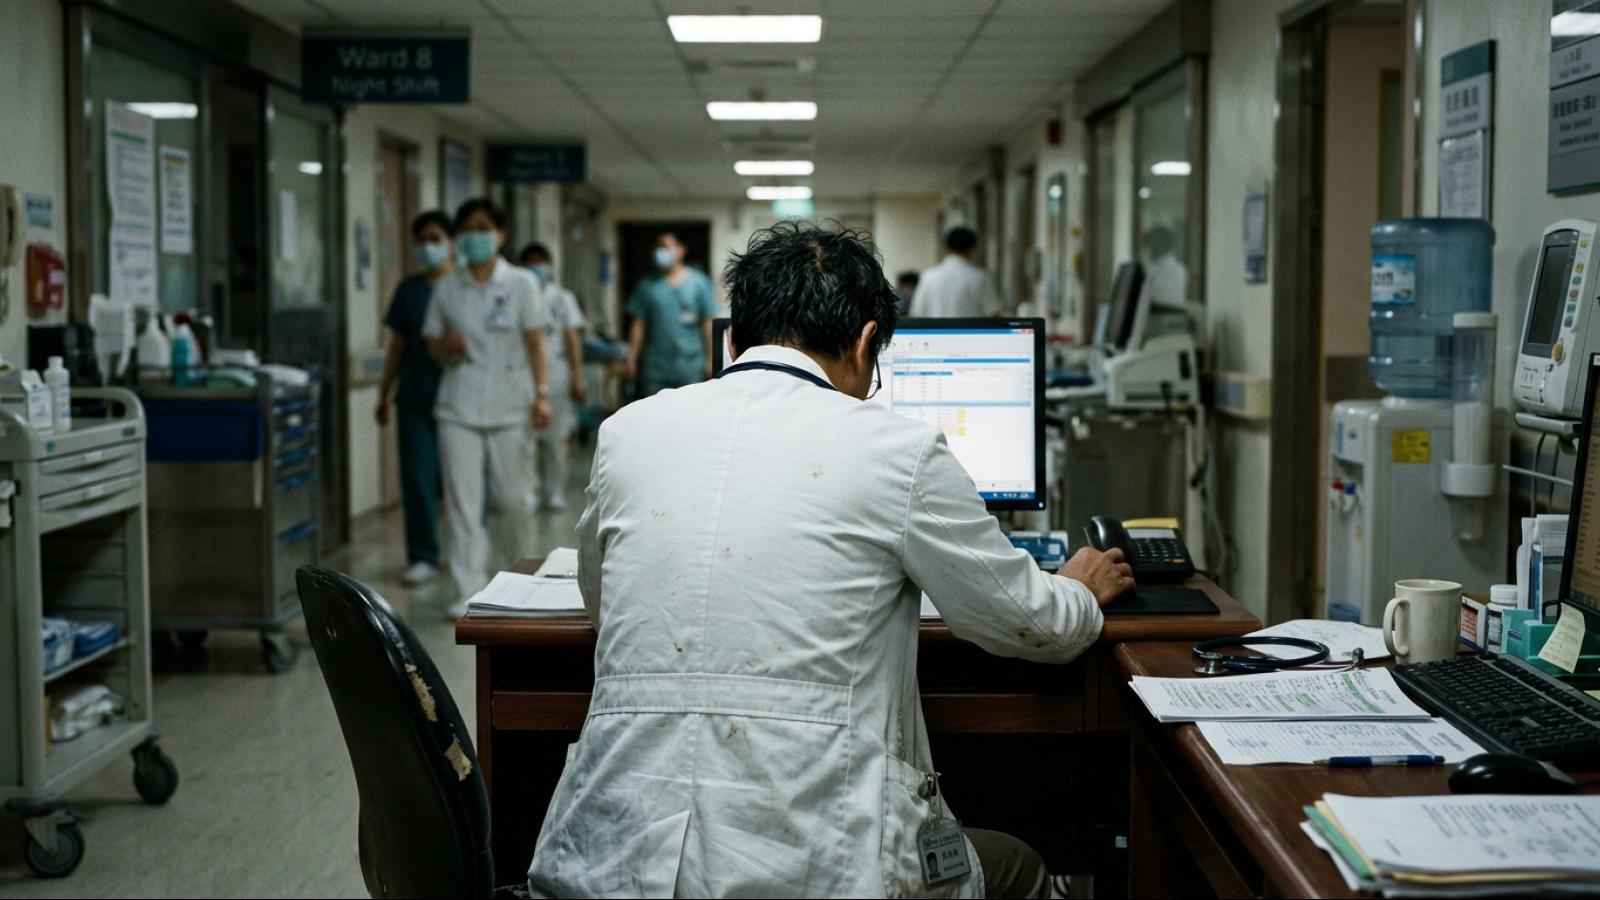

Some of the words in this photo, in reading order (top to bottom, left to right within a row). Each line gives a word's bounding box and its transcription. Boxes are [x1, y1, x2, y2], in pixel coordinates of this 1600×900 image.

[337, 46, 408, 69] Ward
[415, 46, 433, 69] 8
[331, 77, 386, 99] Night
[392, 76, 440, 95] Shift
